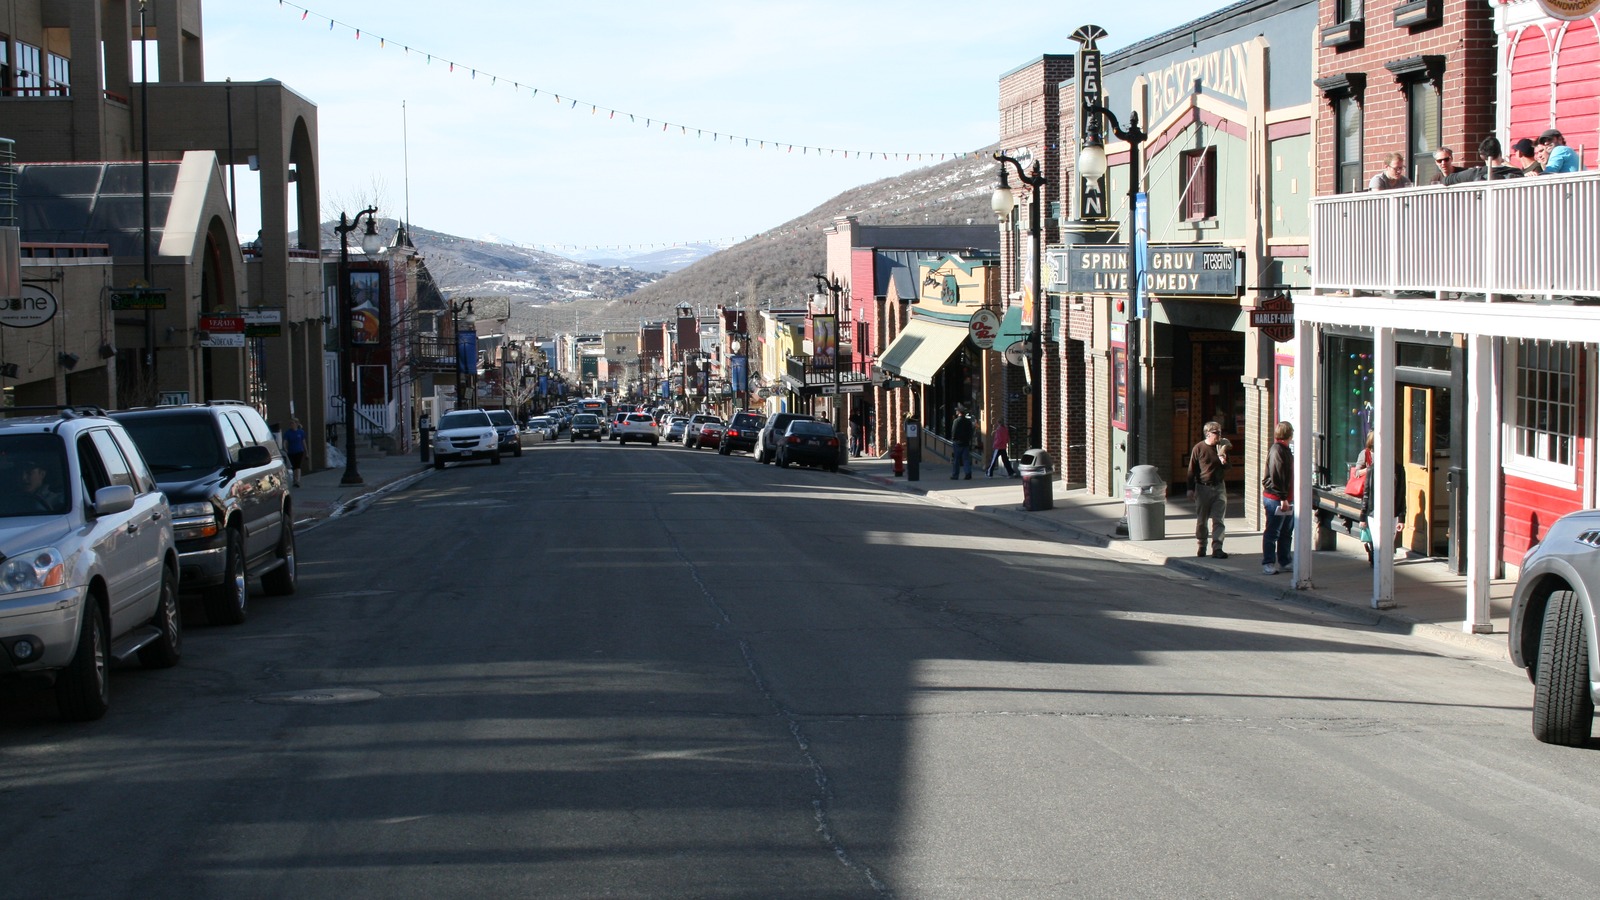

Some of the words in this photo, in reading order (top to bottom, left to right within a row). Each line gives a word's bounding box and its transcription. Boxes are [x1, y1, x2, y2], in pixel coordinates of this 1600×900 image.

[1148, 41, 1248, 128] EGYPTIAN
[1081, 253, 1129, 269] SPRIN
[1152, 253, 1195, 269] GRUV
[1094, 273, 1128, 290] LIVE
[1147, 273, 1200, 290] OMEDY
[815, 357, 833, 365] STYLE
[160, 393, 188, 405] ATM
